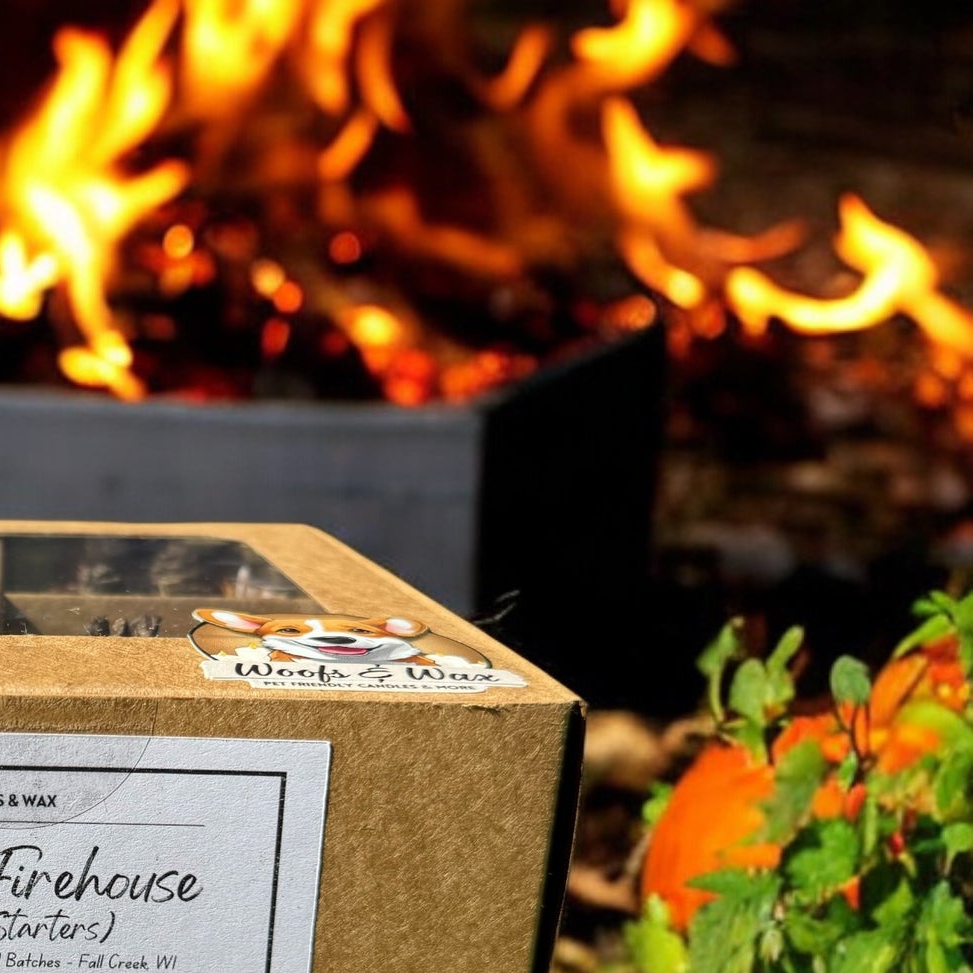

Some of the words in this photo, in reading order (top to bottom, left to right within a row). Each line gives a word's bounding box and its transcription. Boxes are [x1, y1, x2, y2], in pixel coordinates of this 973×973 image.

[234, 662, 350, 683] Woofs
[358, 664, 393, 683] &
[406, 667, 499, 682] Wax
[8, 793, 19, 808] &
[22, 794, 57, 808] WAX
[5, 952, 61, 968] Batches
[78, 953, 105, 969] Fall
[156, 954, 178, 970] WI
